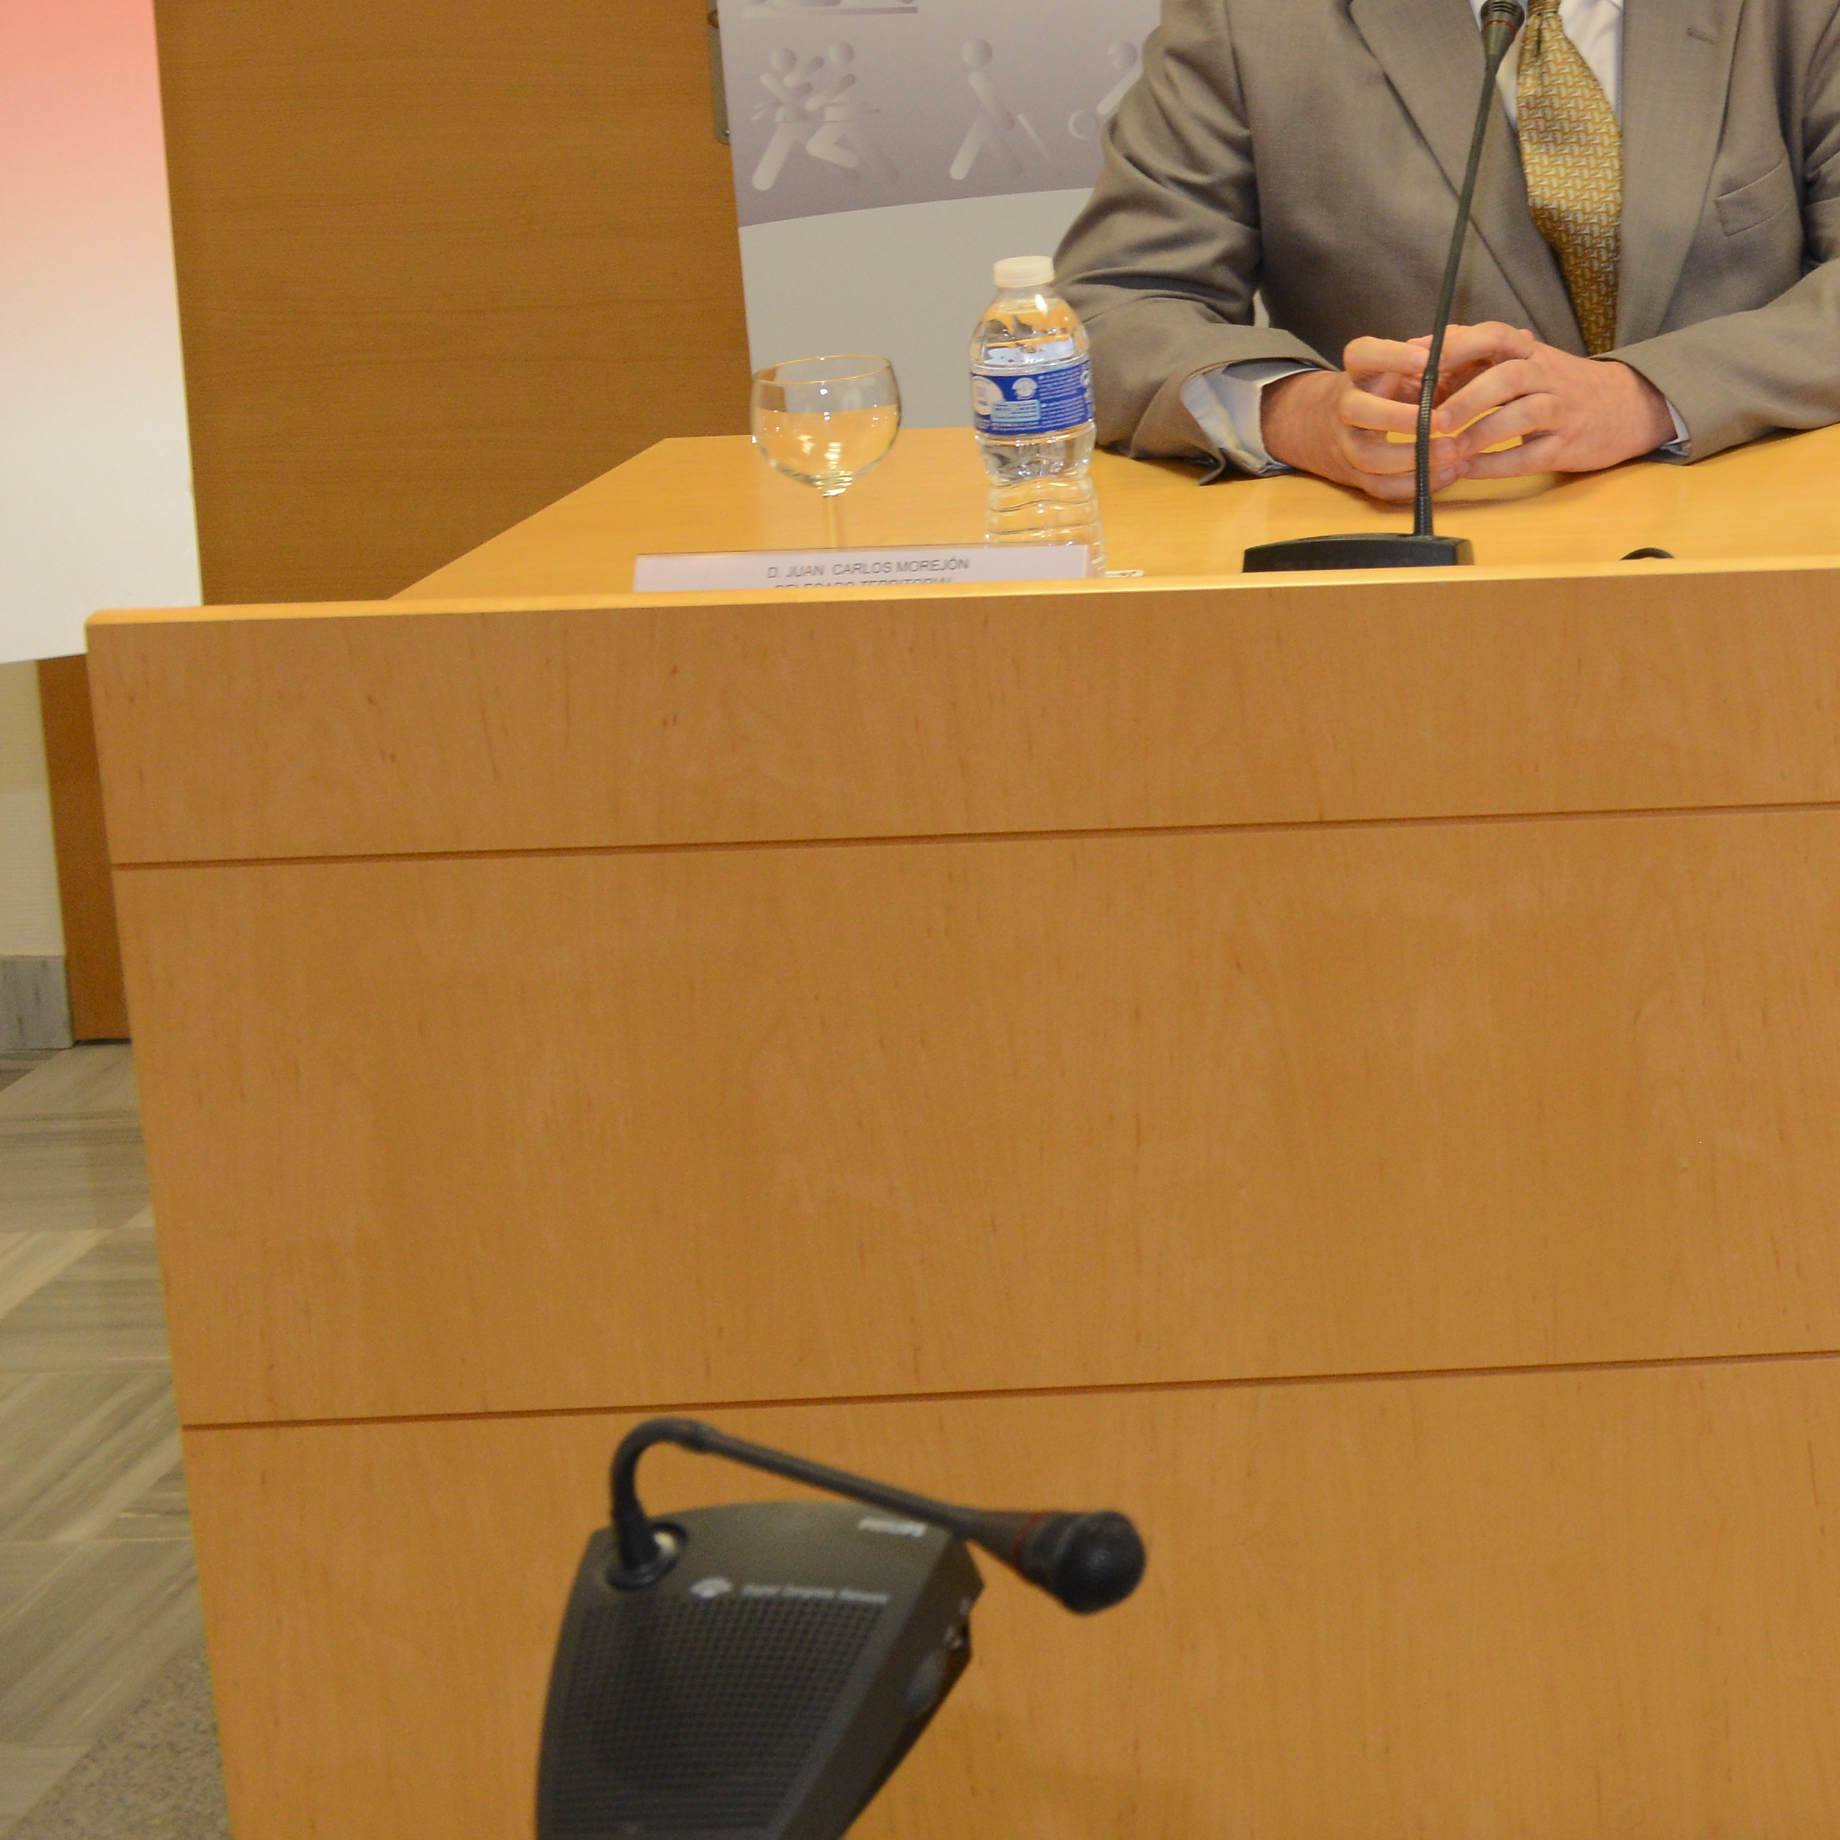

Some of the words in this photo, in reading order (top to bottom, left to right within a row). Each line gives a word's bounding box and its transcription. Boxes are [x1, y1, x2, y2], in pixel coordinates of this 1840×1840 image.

[785, 564, 825, 578] JUAN
[831, 561, 892, 576] CARLOS
[895, 557, 971, 574] MOREJÓN
